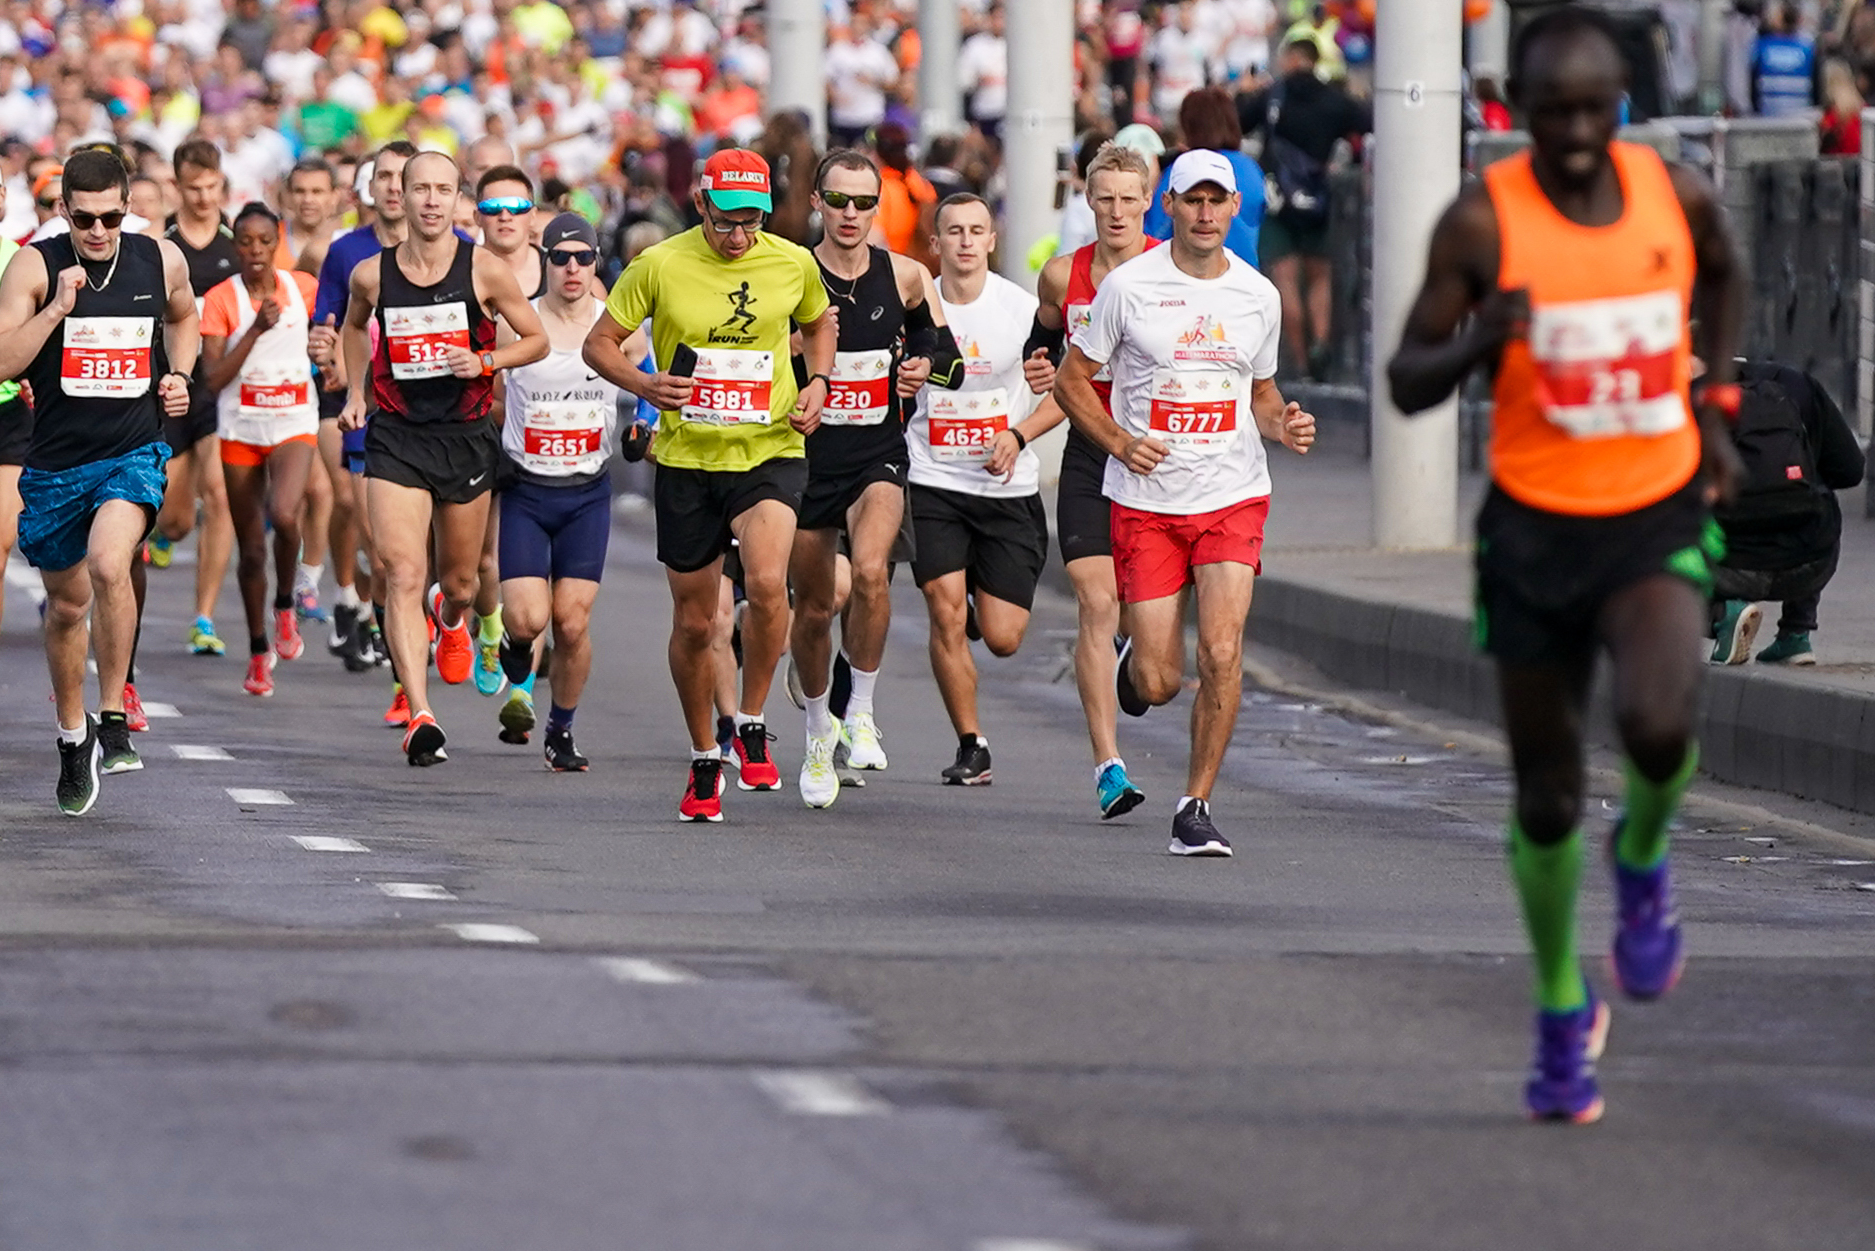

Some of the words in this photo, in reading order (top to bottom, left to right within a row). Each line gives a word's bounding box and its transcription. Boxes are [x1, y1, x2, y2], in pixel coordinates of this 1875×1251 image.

[81, 359, 137, 379] 3812
[699, 389, 754, 410] 5981
[830, 390, 871, 408] 230
[1167, 412, 1224, 432] 6777
[539, 438, 588, 456] 2651
